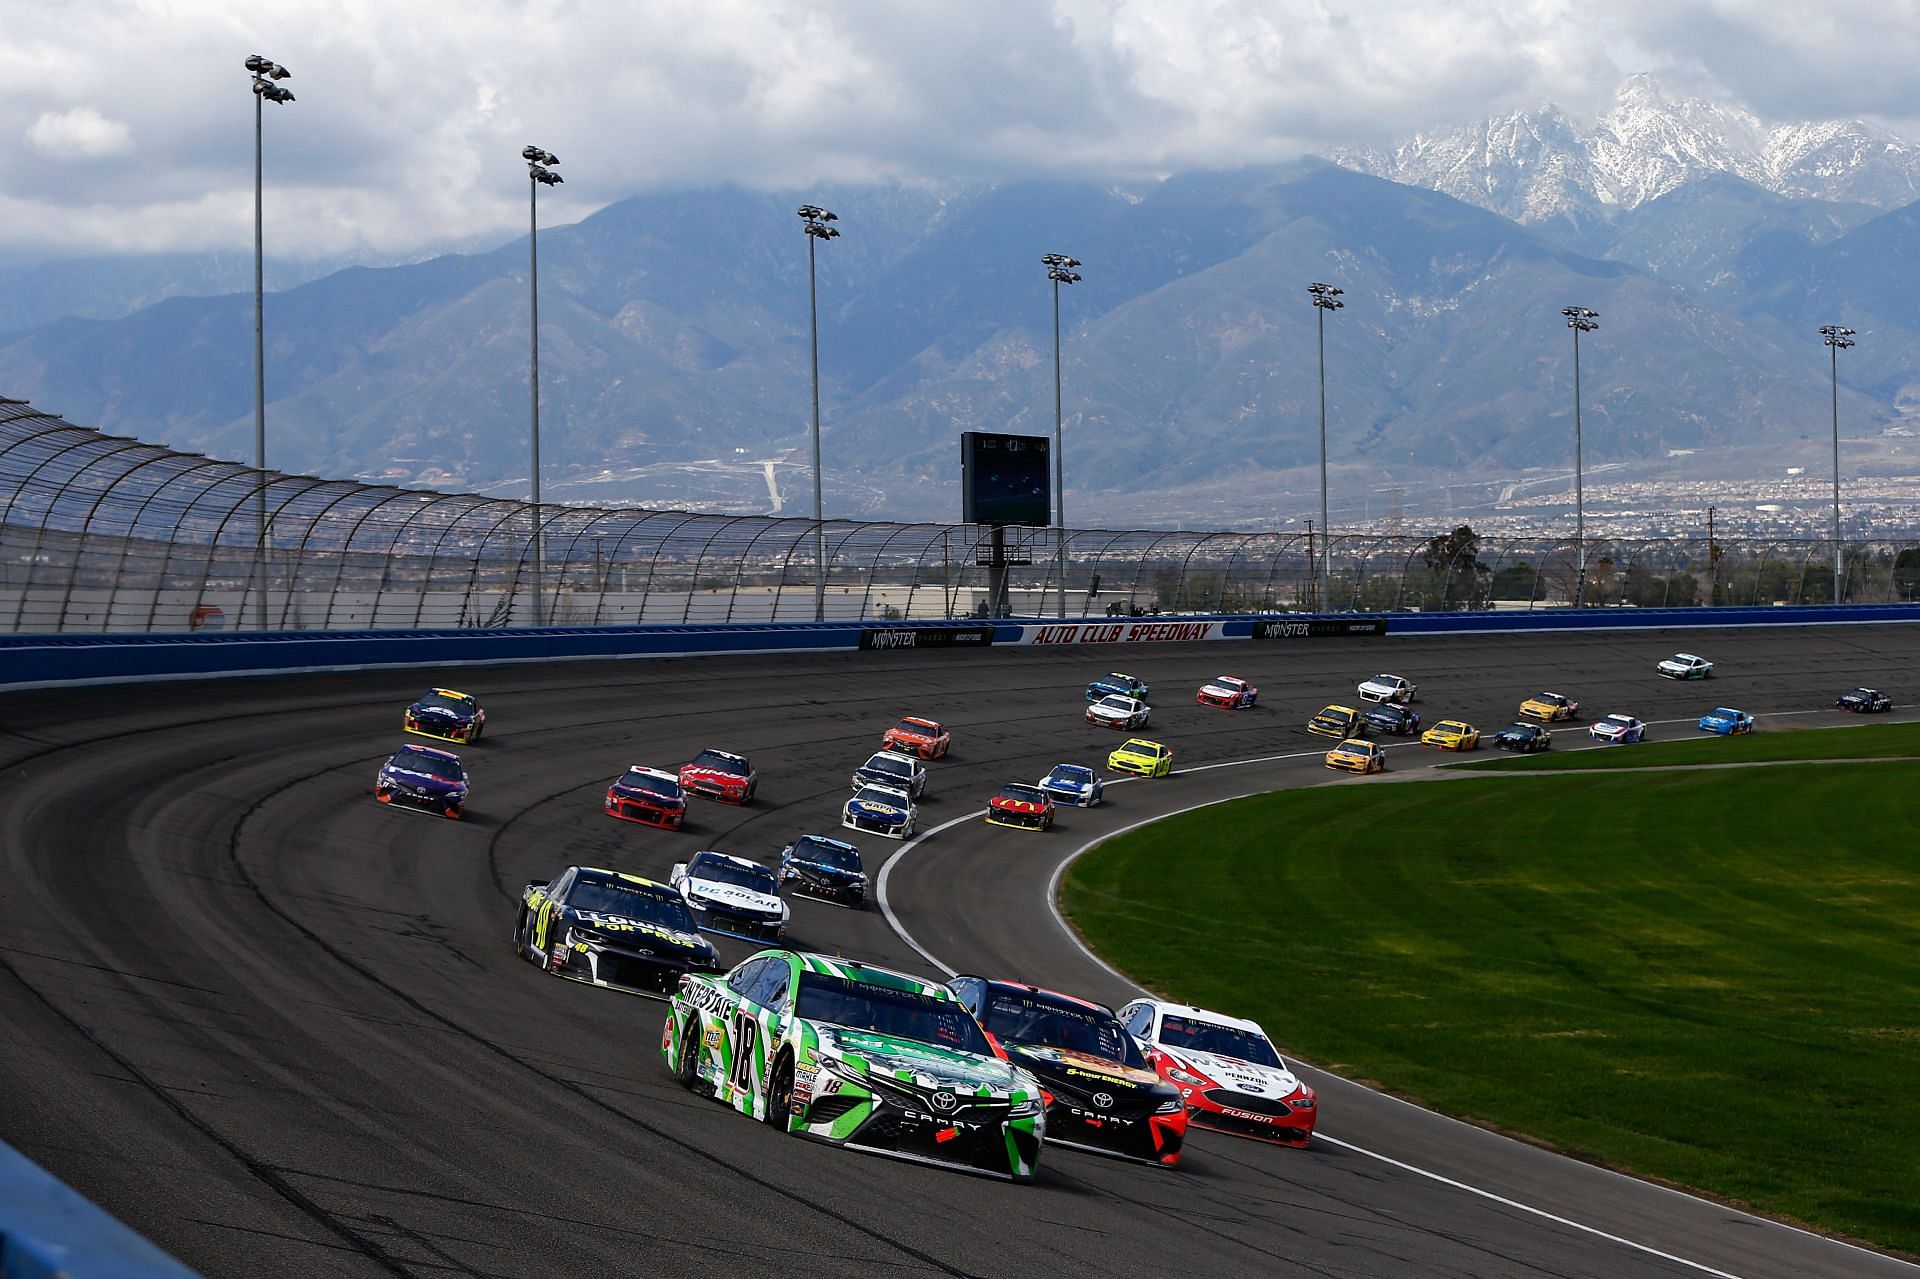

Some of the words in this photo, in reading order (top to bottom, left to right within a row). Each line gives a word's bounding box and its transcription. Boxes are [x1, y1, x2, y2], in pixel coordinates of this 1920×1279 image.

[1032, 626, 1077, 644] AUTO
[1080, 624, 1124, 643] CLUB
[1126, 622, 1214, 642] SPEEDWAY
[1265, 622, 1310, 638] MONSTER
[871, 629, 917, 649] MONSTER
[864, 802, 893, 813] NAPA
[698, 885, 720, 894] DC
[723, 890, 778, 910] SOLAR
[594, 921, 635, 933] FOR
[641, 927, 696, 949] PROS
[574, 942, 589, 953] 48
[859, 983, 917, 1000] MONSTER
[682, 980, 734, 1021] INTERSTATE
[1036, 1003, 1084, 1020] MONSTER
[728, 1010, 759, 1094] 18
[821, 1078, 843, 1094] 18
[1066, 1068, 1102, 1081] 5-hour
[1101, 1074, 1138, 1089] ENERGY
[1225, 1071, 1269, 1086] PENNZOIL
[1181, 1088, 1192, 1098] 2
[1241, 1084, 1260, 1092] Ford
[904, 1111, 981, 1131] CAMRY
[1071, 1108, 1133, 1127] CAMRY
[1221, 1108, 1274, 1124] FUSION
